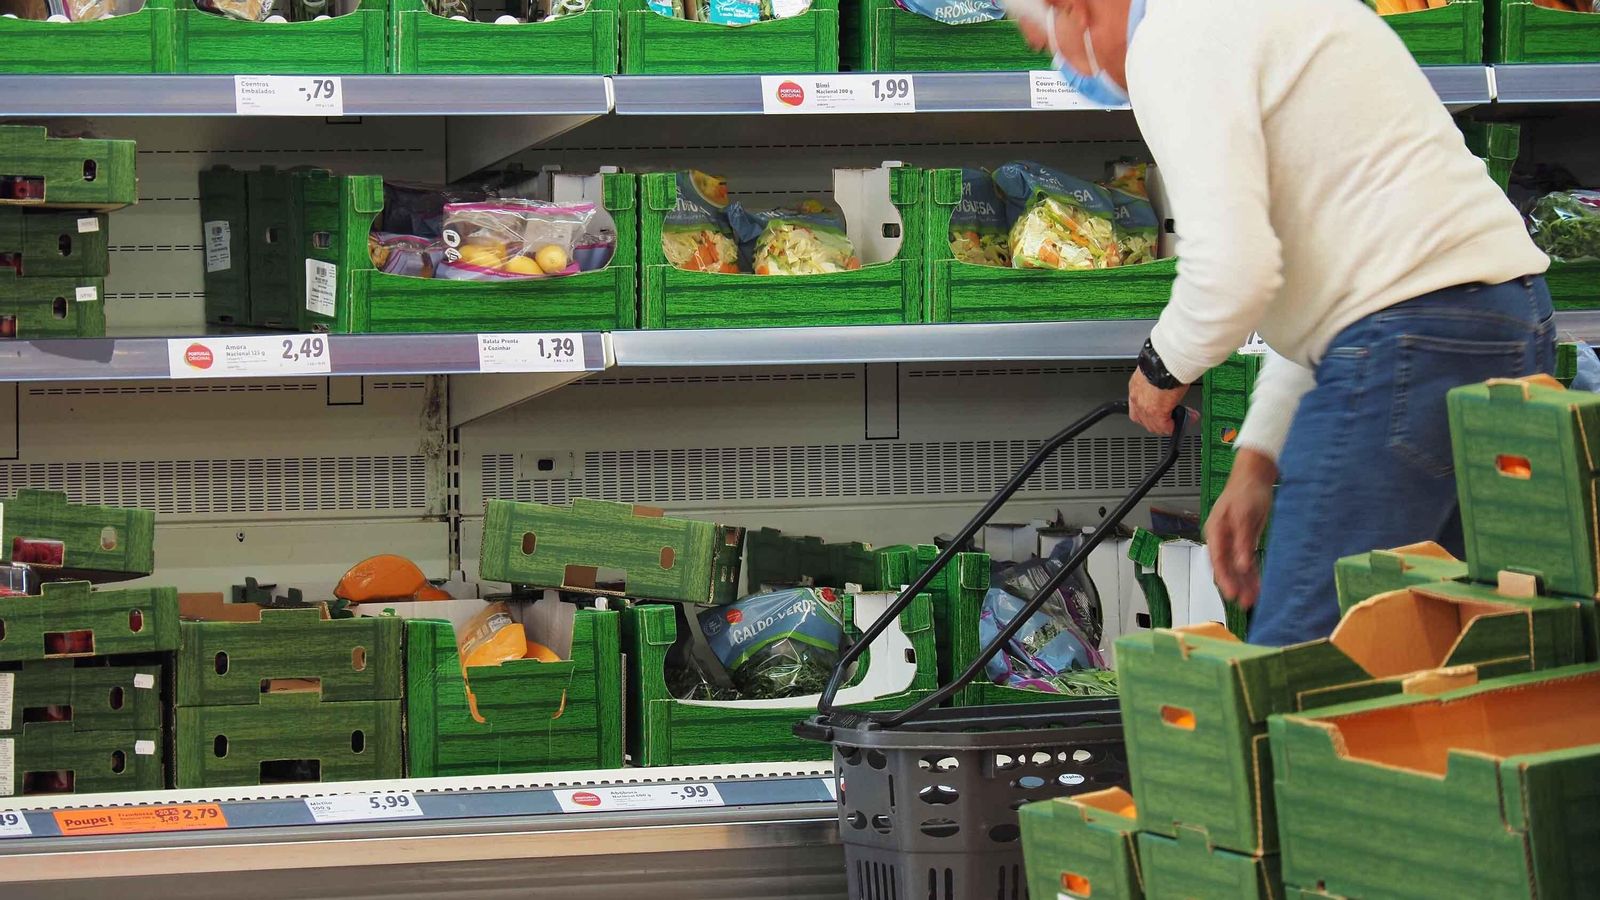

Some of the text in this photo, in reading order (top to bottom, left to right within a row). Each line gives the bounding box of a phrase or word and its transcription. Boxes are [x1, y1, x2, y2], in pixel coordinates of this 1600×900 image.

[298, 79, 335, 101] -,79
[871, 78, 909, 102] 1,99
[282, 337, 324, 362] 2,49
[537, 337, 575, 359] 1,79
[369, 795, 410, 809] 5,99
[670, 785, 709, 801] -,99
[64, 815, 114, 827] Poupe!
[182, 808, 218, 820] 2,79
